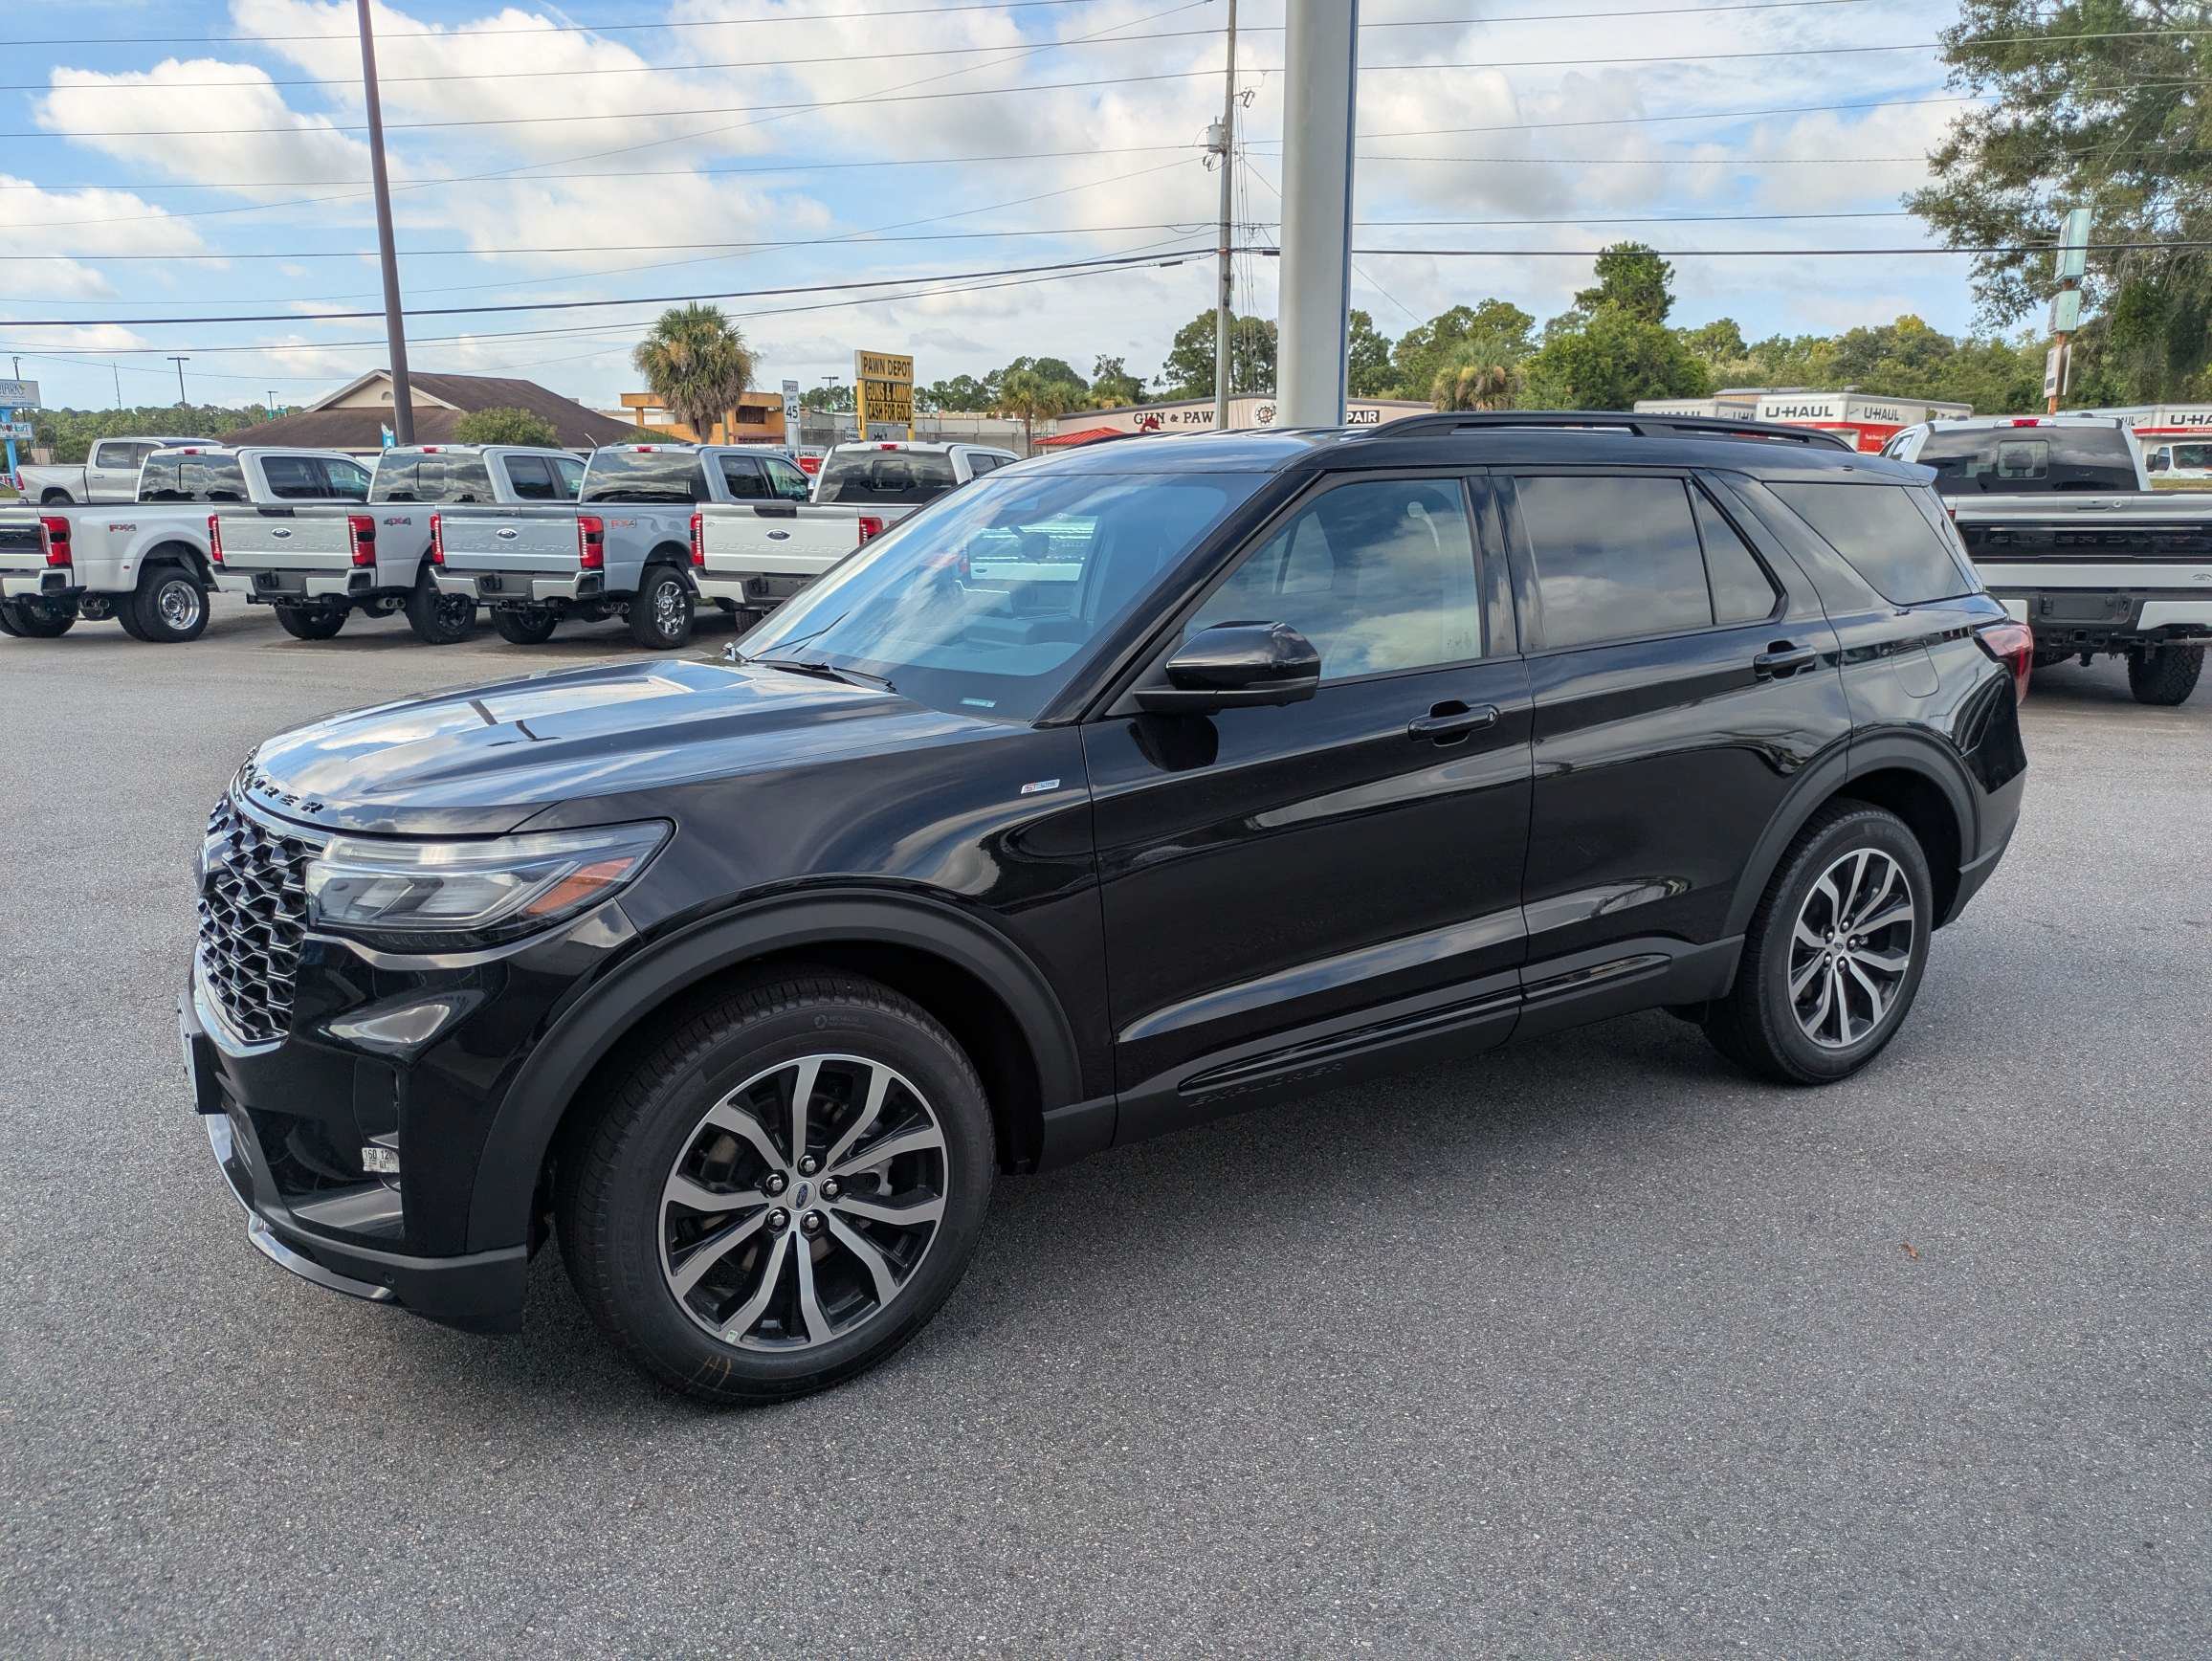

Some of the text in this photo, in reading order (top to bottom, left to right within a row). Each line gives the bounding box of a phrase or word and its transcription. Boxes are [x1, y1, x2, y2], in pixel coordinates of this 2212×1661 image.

[863, 356, 912, 377] PAWN DEPOT
[866, 382, 885, 400] GUNS
[892, 384, 911, 402] AMMO
[785, 405, 798, 419] 45
[867, 403, 912, 421] CASH FOR GOLD
[1133, 412, 1165, 424] GUN
[1170, 414, 1178, 423] &
[1765, 406, 1834, 417] U-HAUL
[1864, 407, 1899, 421] U-HAUL
